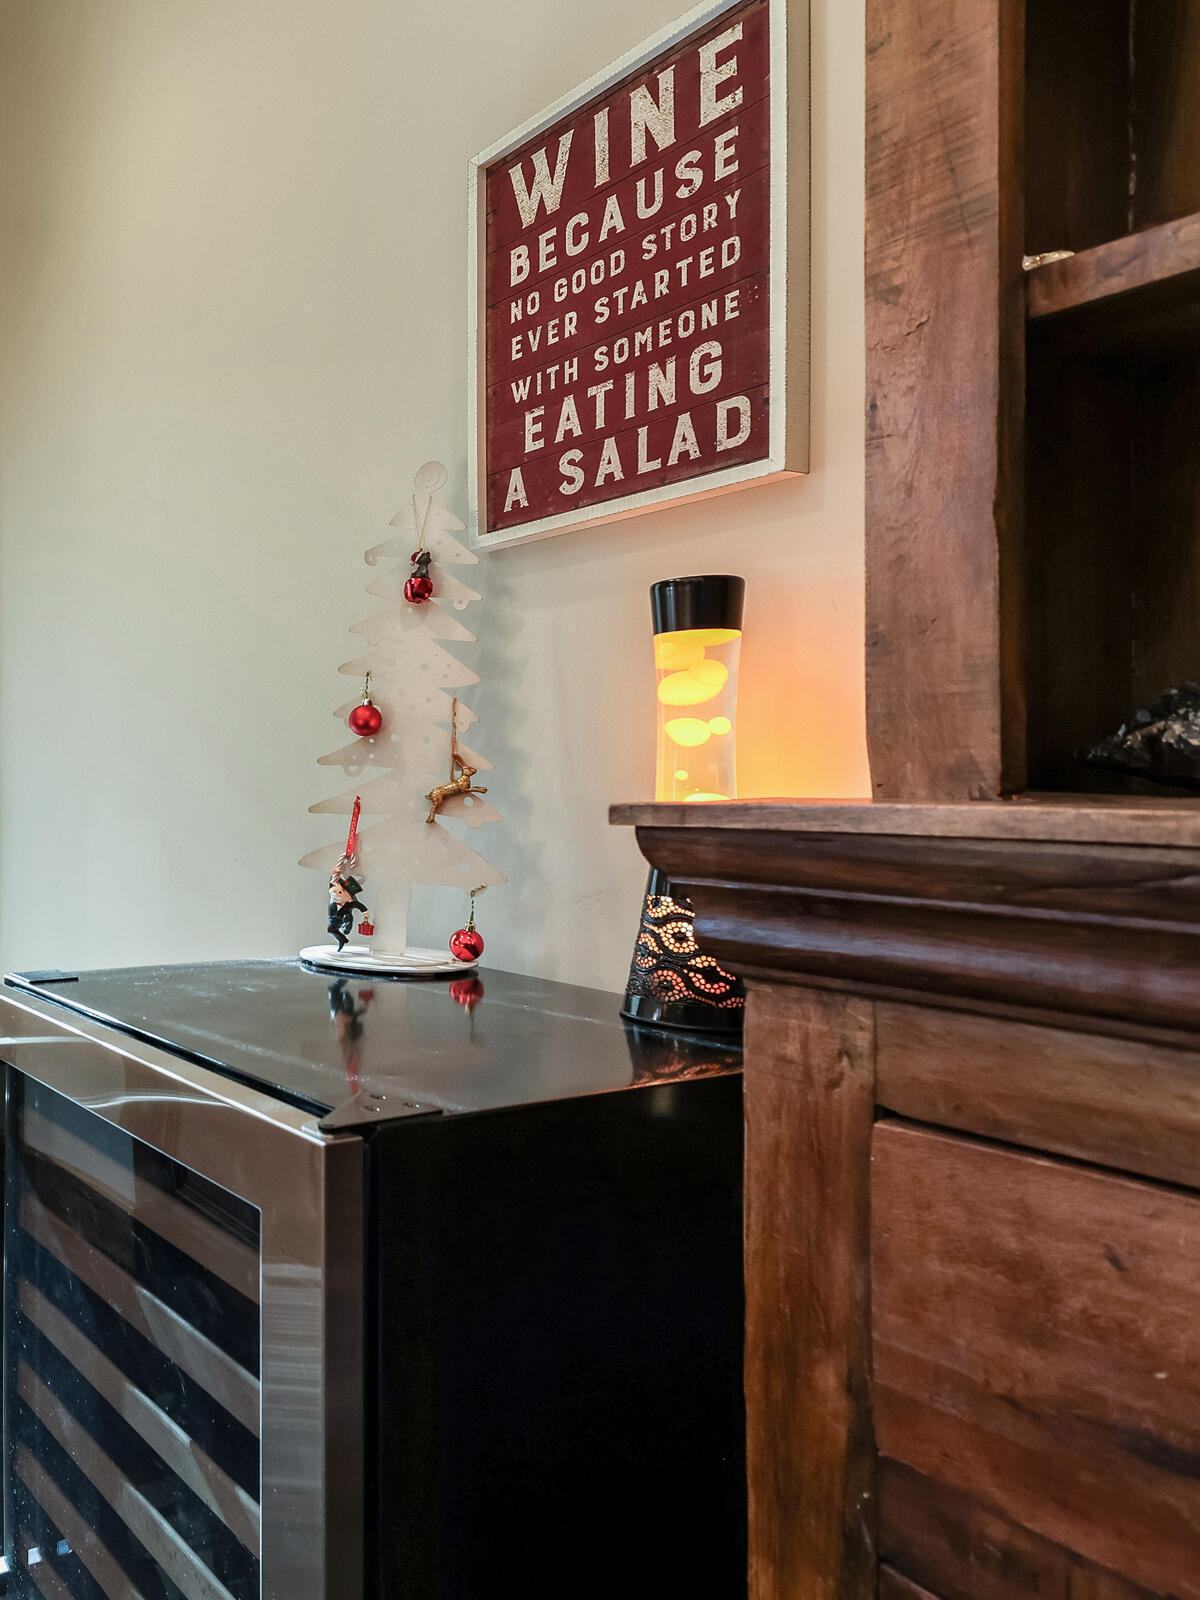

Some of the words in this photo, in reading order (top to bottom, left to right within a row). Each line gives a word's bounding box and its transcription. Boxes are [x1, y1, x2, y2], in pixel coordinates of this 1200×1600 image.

[508, 22, 743, 229] WINE
[509, 126, 739, 288] BECAUSE
[509, 295, 541, 324] NO
[553, 249, 626, 302] GOOD
[641, 189, 742, 261] STORY
[511, 316, 578, 361] EVER
[594, 236, 742, 324] STARTED
[511, 362, 579, 404] WITH
[593, 289, 740, 373] SOMEONE
[503, 466, 529, 513] A
[557, 395, 752, 496] SALAD
[523, 340, 723, 454] EATING
